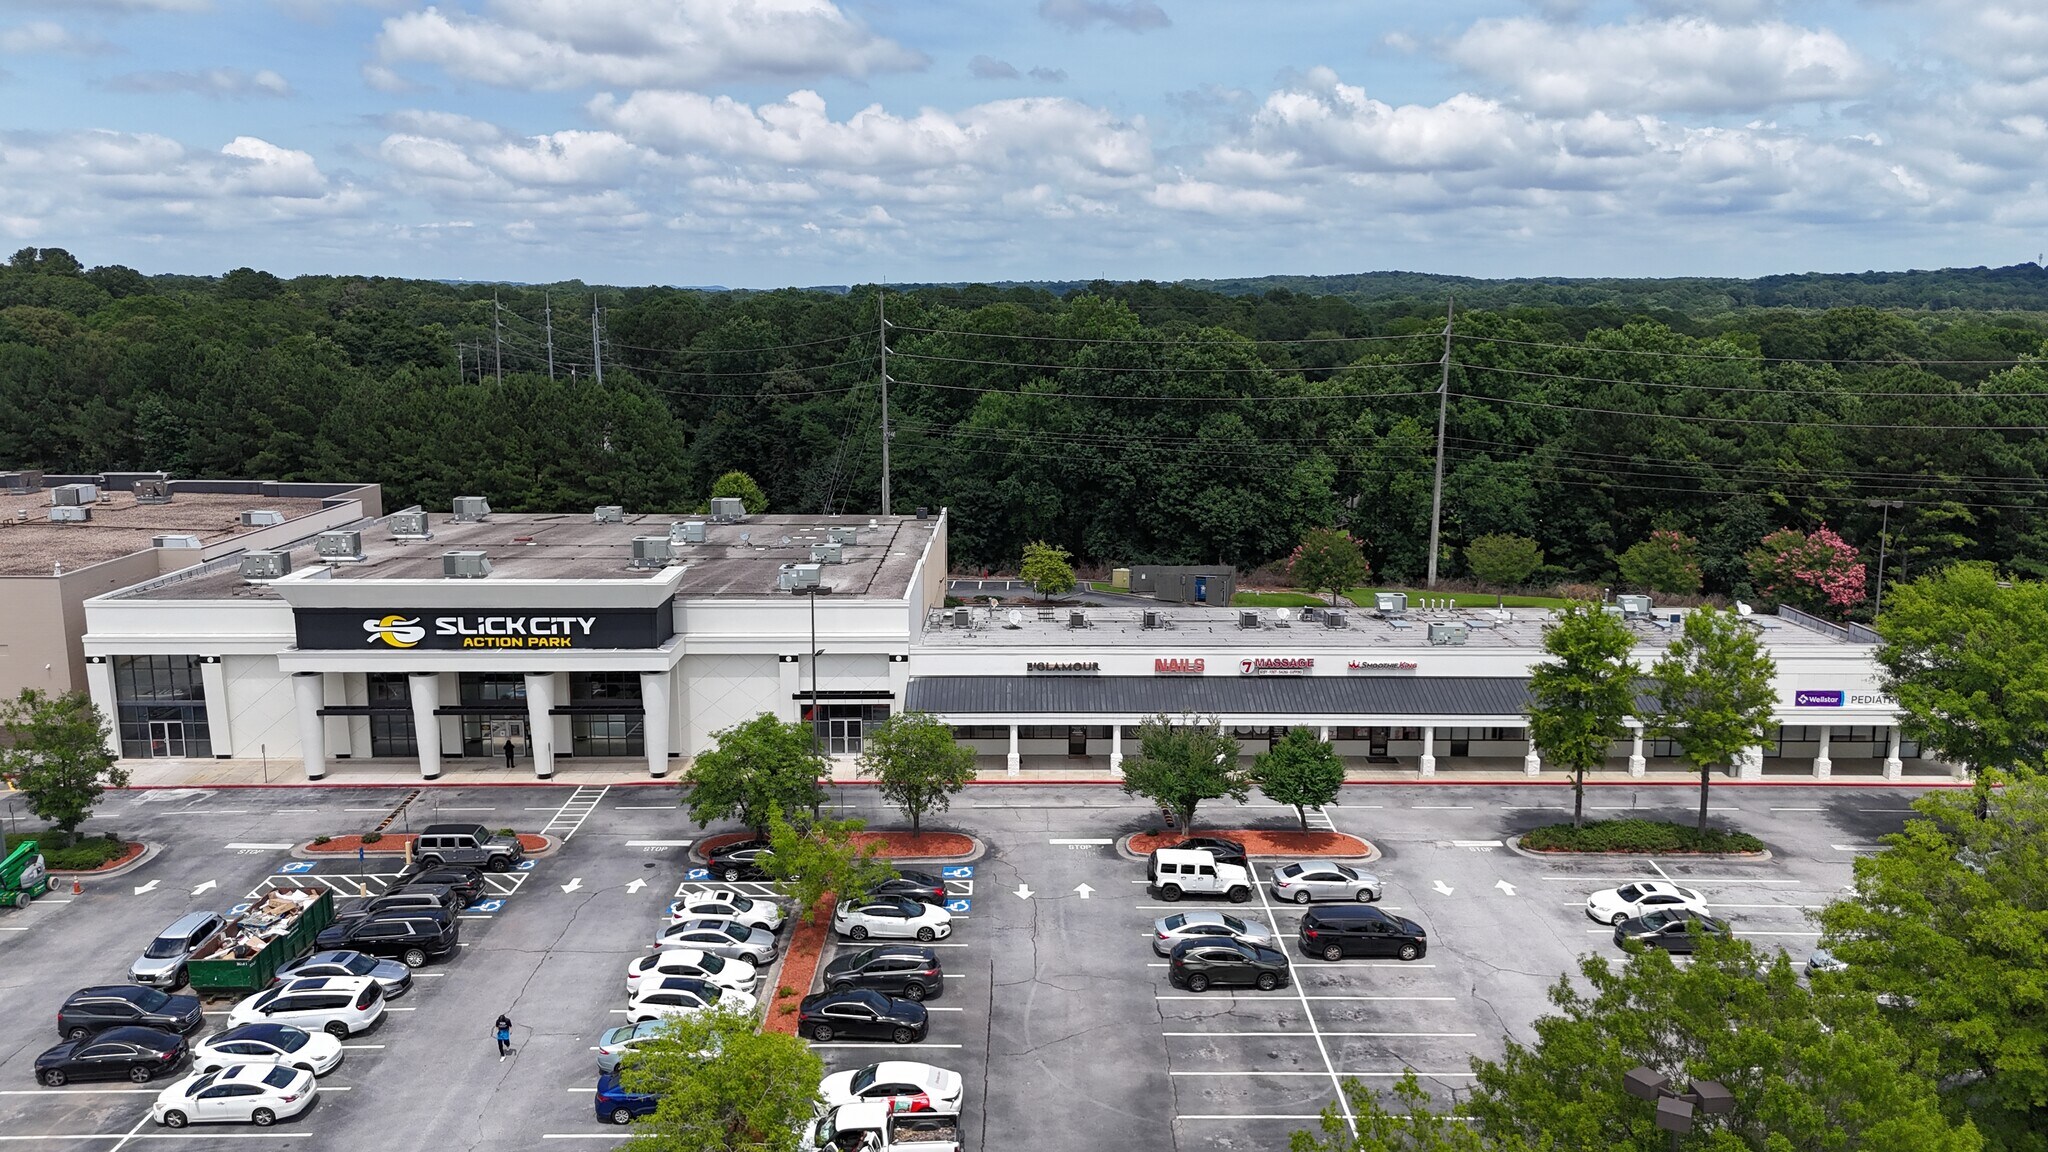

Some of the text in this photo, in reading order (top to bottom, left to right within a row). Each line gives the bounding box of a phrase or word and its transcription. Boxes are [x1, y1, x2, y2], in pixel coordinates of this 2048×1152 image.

[463, 637, 572, 647] ACTION PARK
[1154, 658, 1205, 673] NAILS
[1242, 661, 1252, 673] 7
[1255, 658, 1315, 668] MASSAGE
